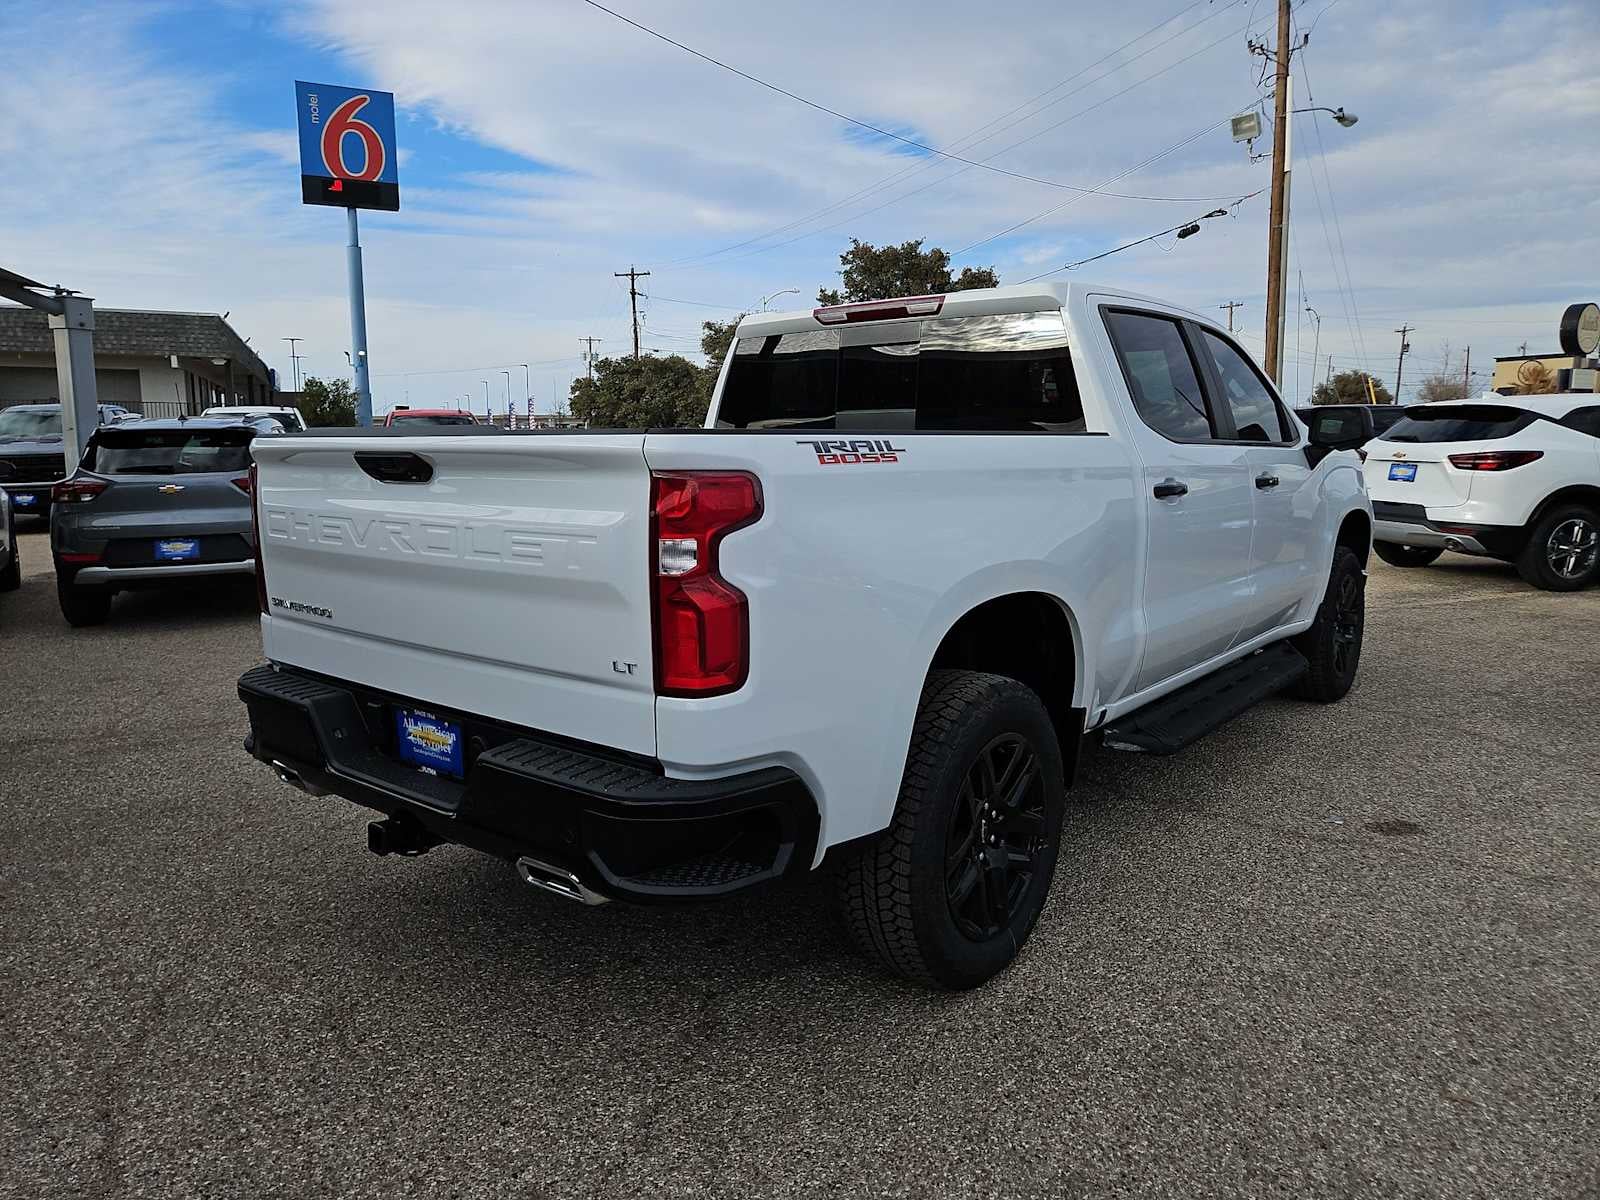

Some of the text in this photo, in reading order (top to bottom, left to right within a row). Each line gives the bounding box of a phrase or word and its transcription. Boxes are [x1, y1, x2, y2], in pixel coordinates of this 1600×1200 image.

[320, 94, 386, 182] 6
[796, 440, 906, 454] TRAIL
[817, 453, 898, 465] BOSS
[266, 510, 598, 570] CHEVROLET
[271, 597, 333, 618] SILVERADO
[612, 660, 638, 676] LT
